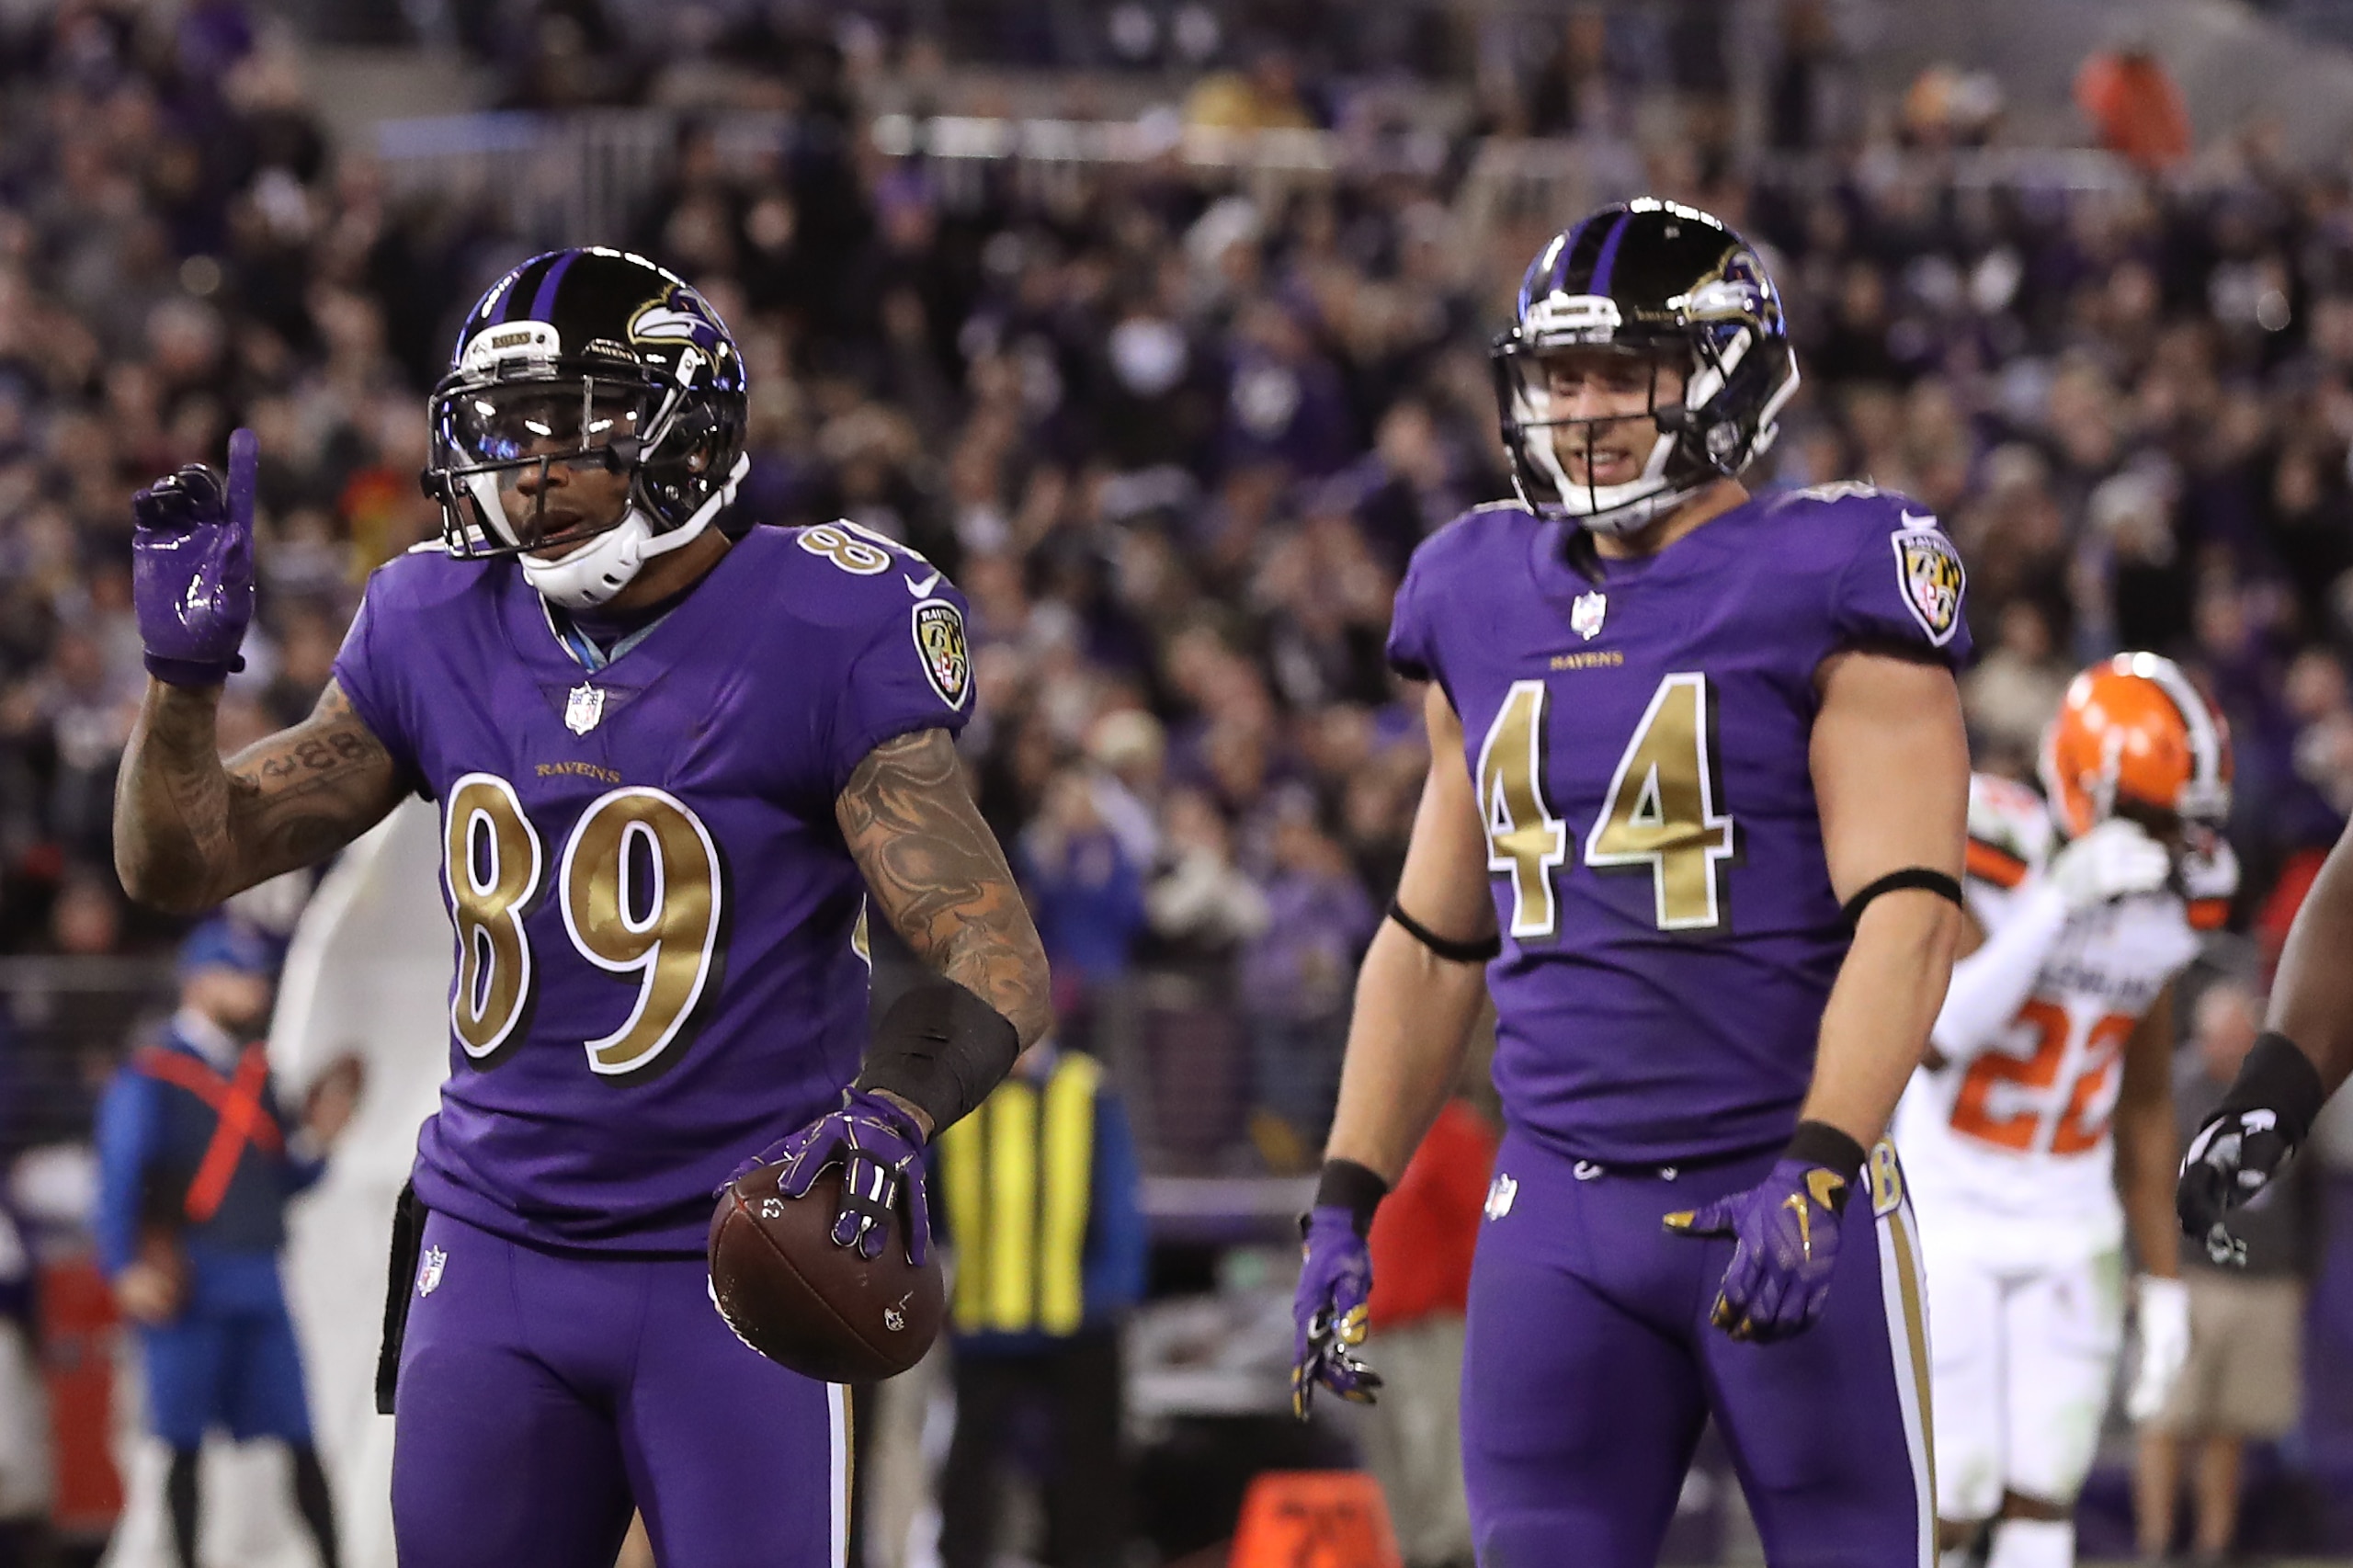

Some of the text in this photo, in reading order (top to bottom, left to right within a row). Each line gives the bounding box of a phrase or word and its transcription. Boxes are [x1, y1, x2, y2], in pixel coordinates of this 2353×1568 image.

[1549, 650, 1625, 671] RAVENS
[534, 760, 622, 784] RAVENS
[1476, 672, 1734, 937] 44
[445, 772, 723, 1075] 89
